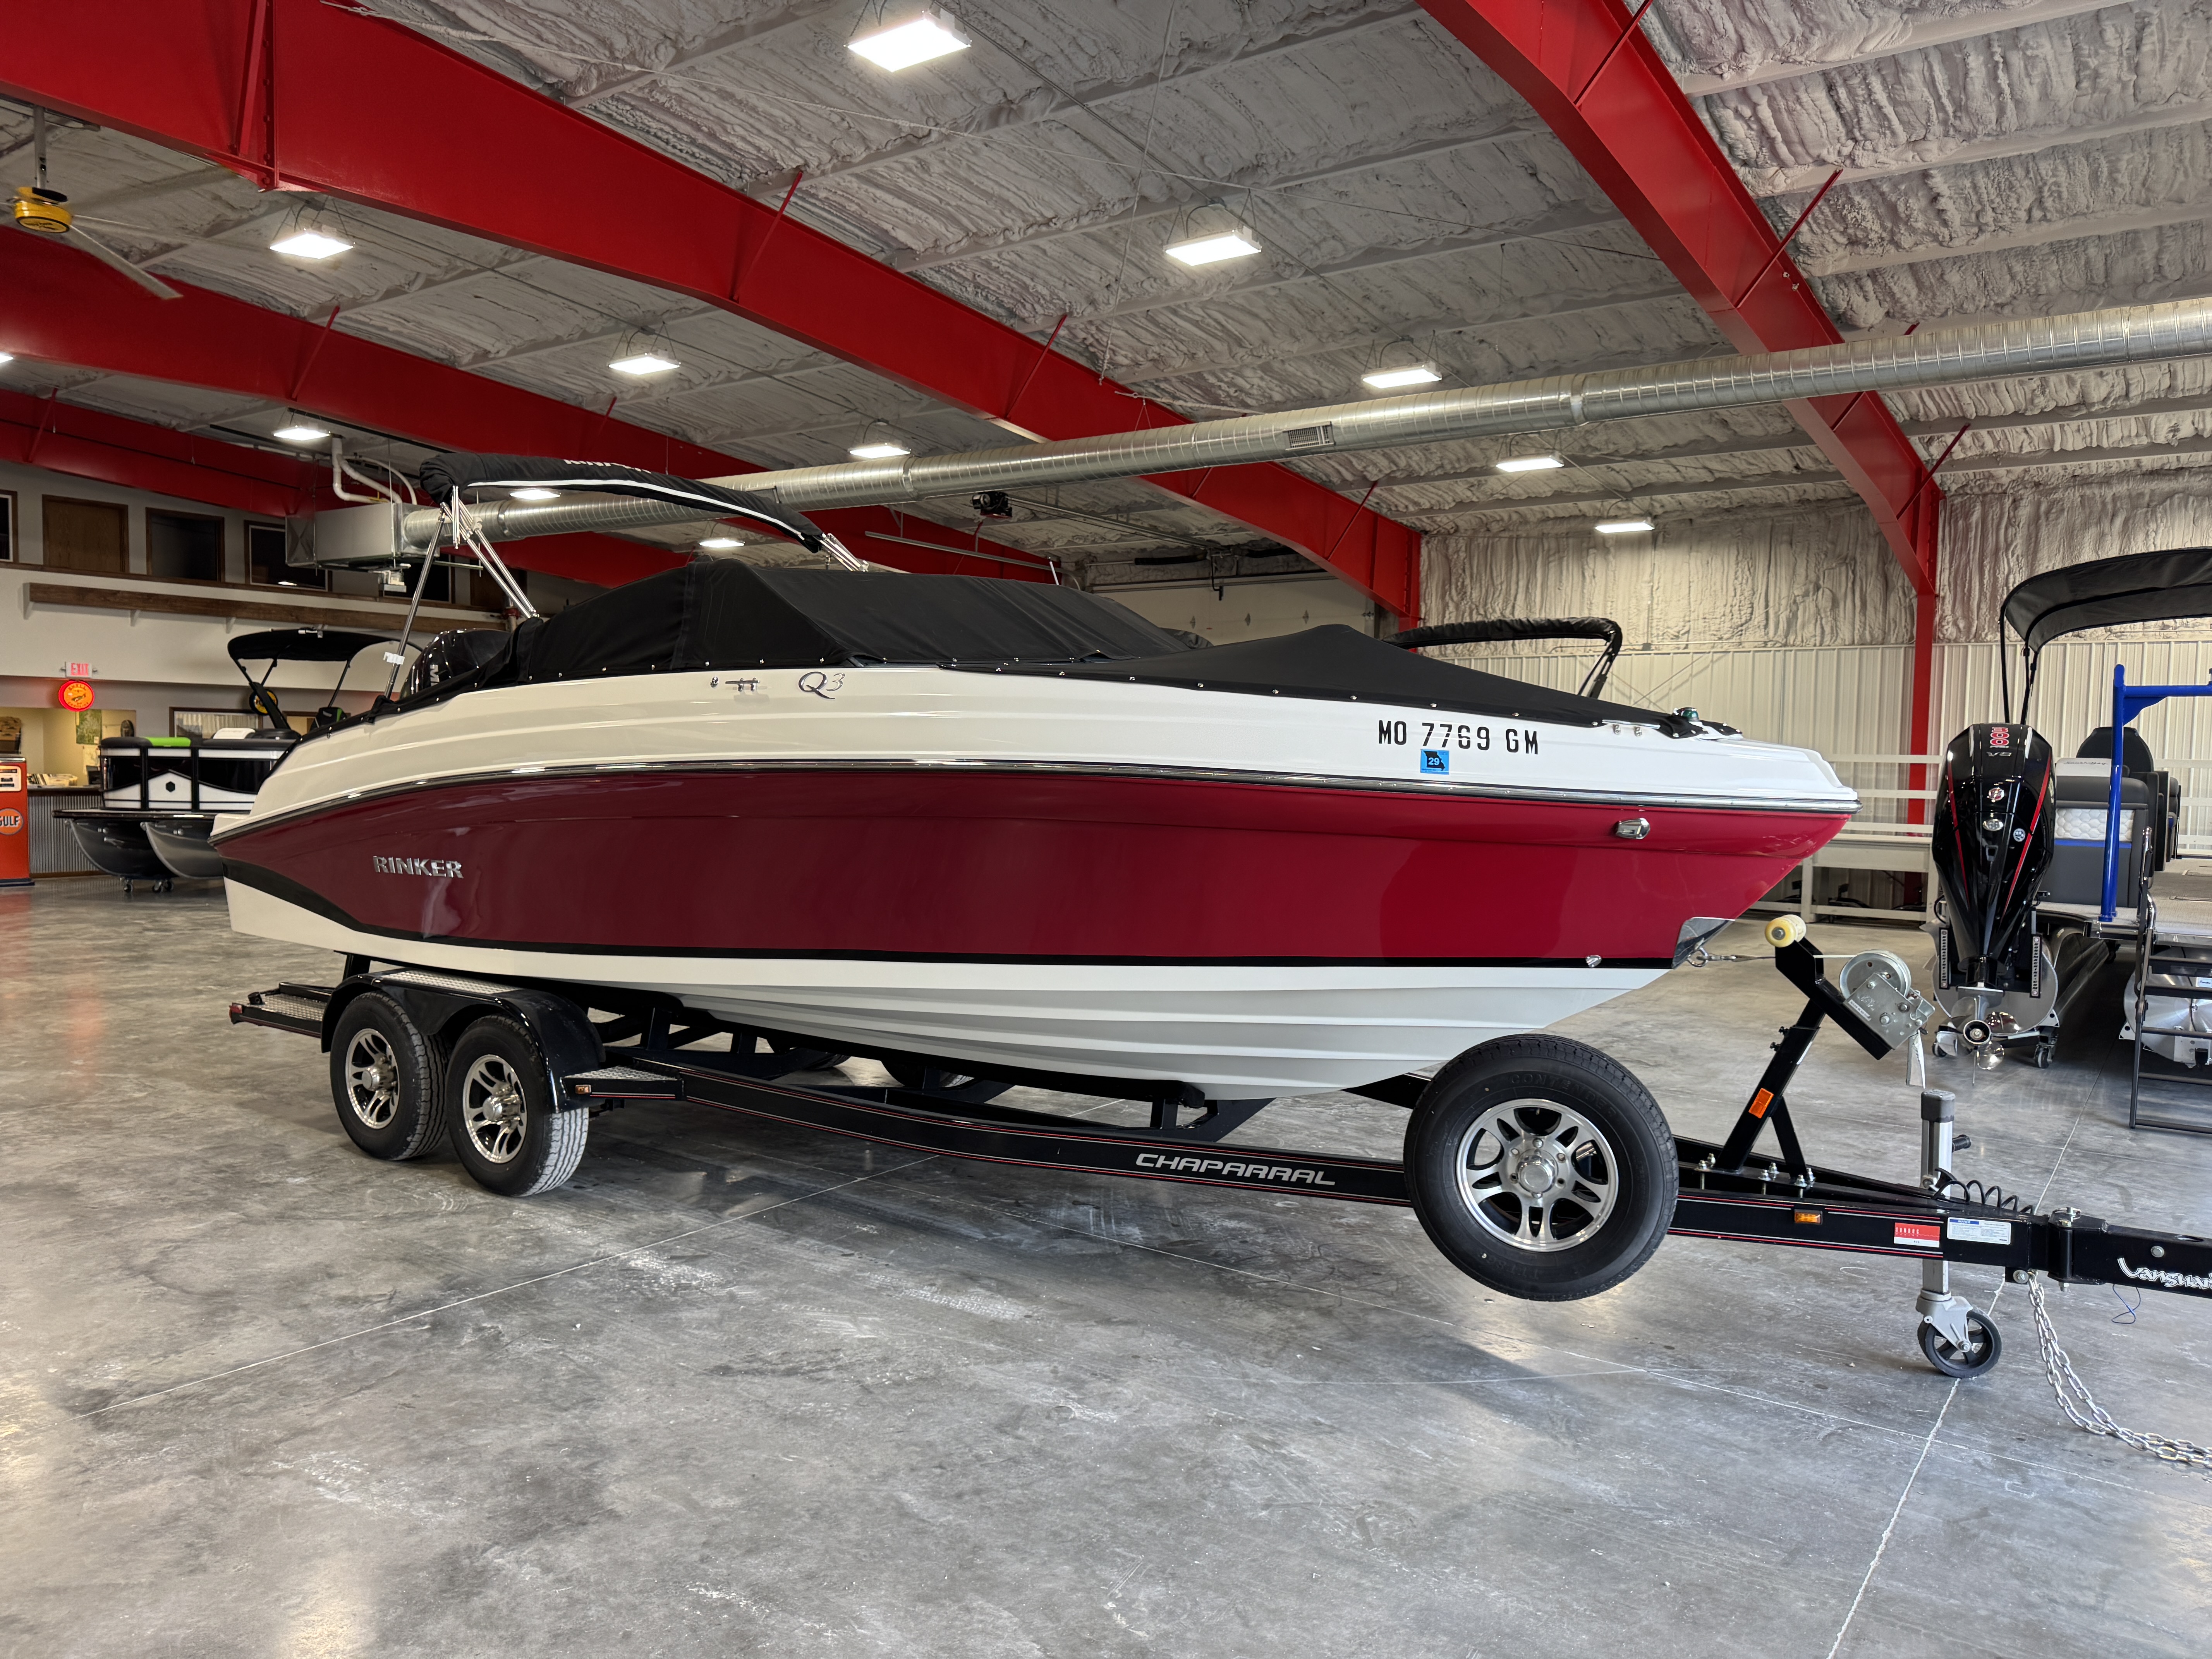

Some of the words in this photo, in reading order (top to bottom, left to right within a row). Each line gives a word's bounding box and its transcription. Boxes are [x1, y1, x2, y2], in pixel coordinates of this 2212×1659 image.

[71, 663, 89, 676] EXIT
[798, 671, 845, 699] Q3
[1379, 720, 1407, 745] MO
[1422, 723, 1490, 750] 7769
[1506, 728, 1538, 755] GM
[1428, 757, 1440, 766] 29
[373, 855, 464, 879] RINKER
[1509, 1073, 1617, 1118] CONTENDER
[1136, 1153, 1336, 1186] CHAPARRAL
[2117, 1257, 2212, 1290] Vanguar
